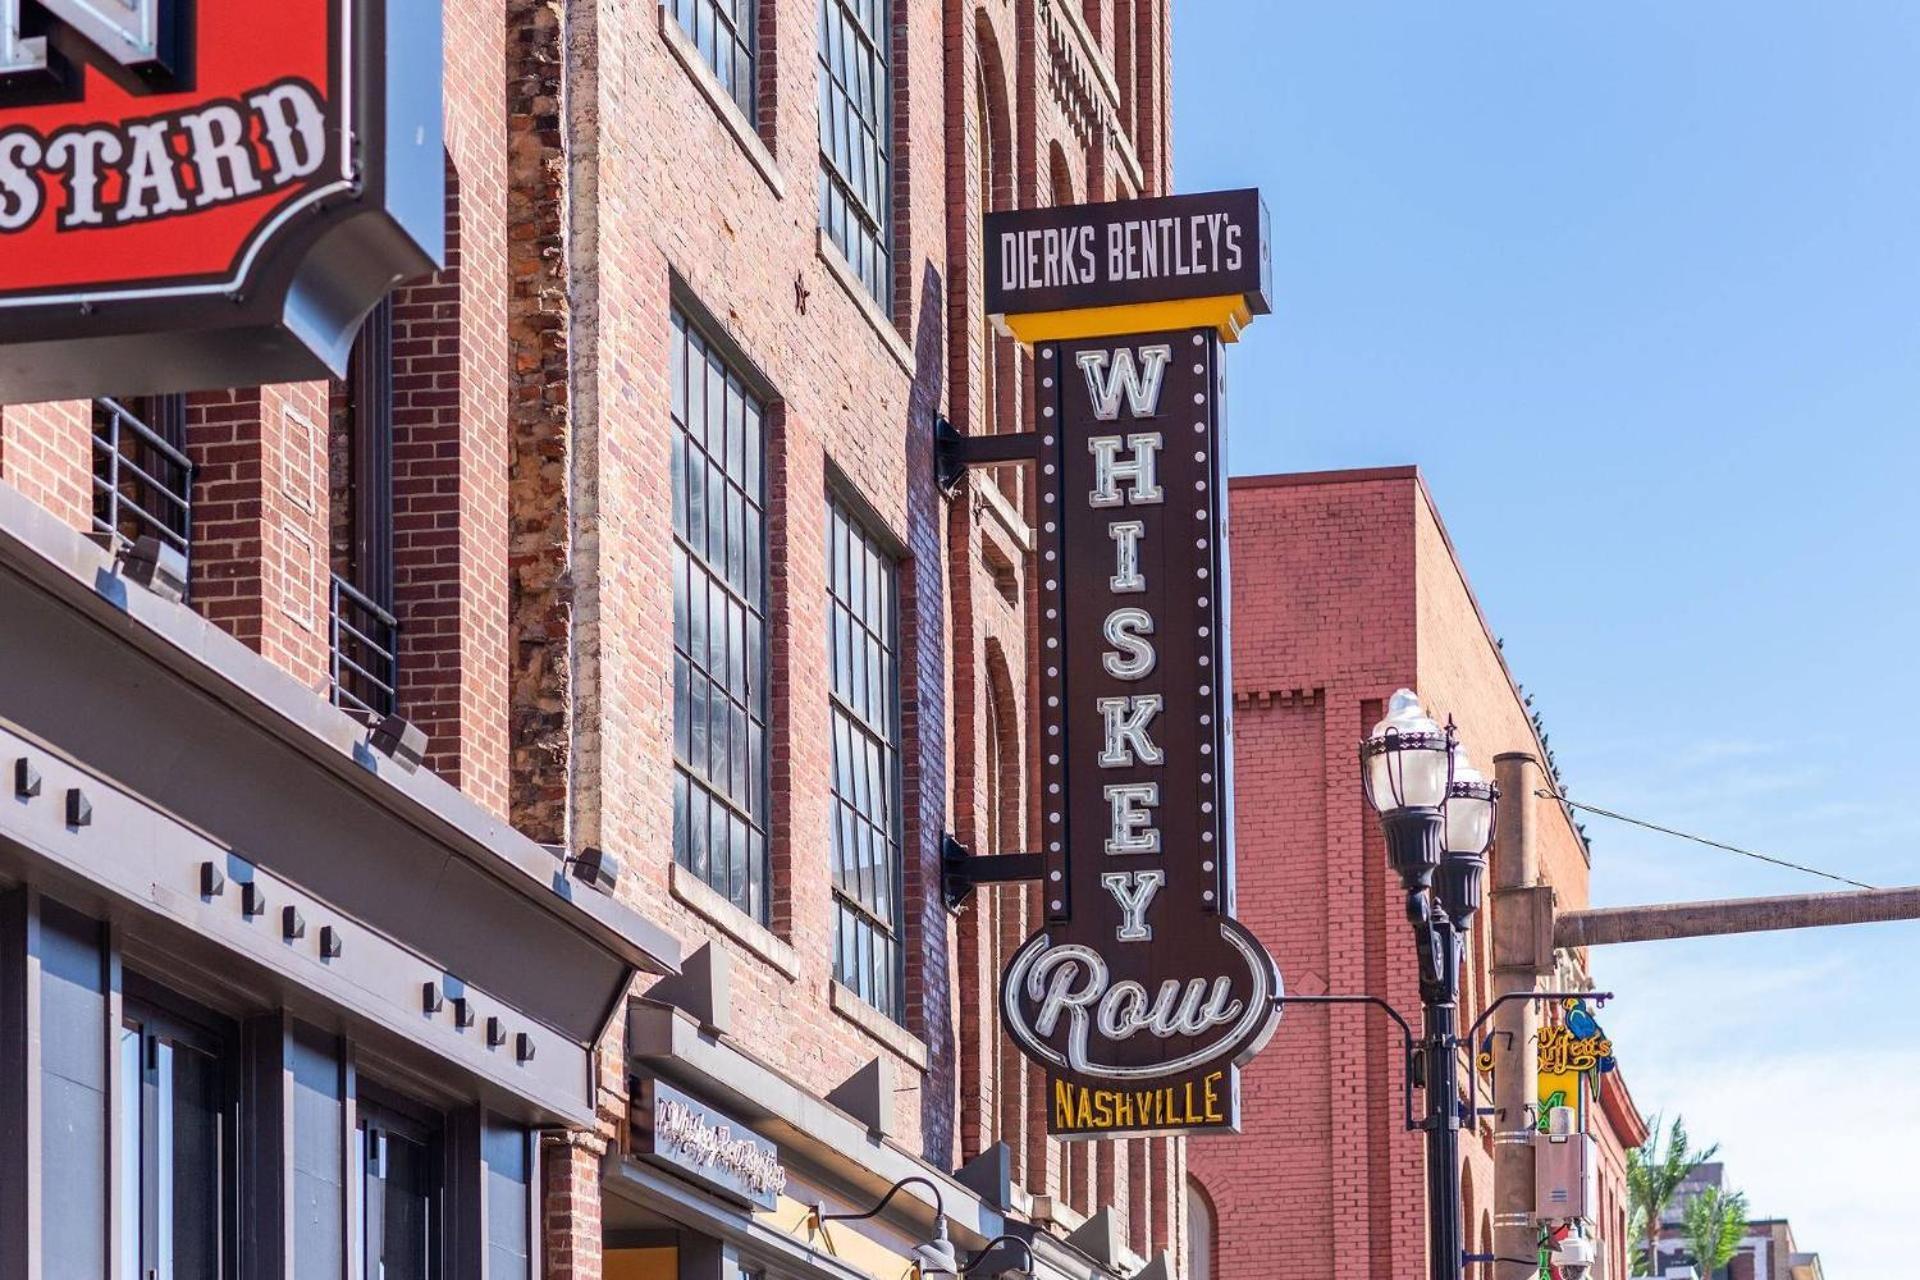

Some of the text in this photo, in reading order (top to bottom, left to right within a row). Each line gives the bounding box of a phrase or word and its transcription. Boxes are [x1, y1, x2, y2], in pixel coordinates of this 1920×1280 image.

[1000, 211, 1242, 291] DIERKS BENTLEY's
[1075, 343, 1172, 943] WHISKEY
[1027, 944, 1243, 1073] Row
[1055, 1071, 1223, 1130] NASHVILLE
